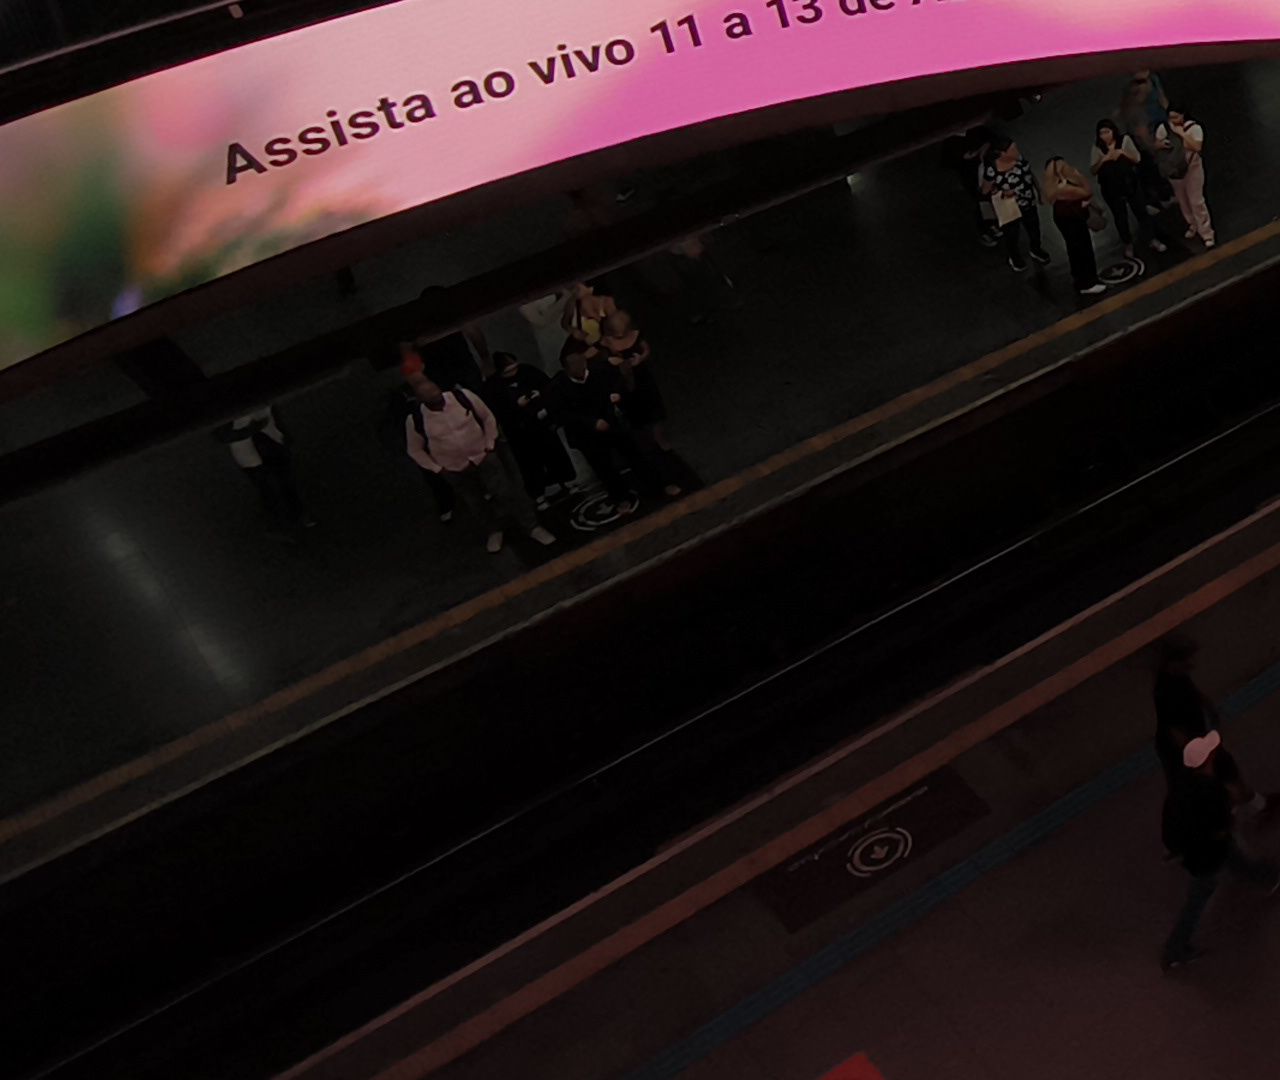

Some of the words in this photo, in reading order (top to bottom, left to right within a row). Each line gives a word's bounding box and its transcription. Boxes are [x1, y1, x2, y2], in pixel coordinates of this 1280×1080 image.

[225, 93, 437, 185] Assista
[450, 70, 516, 110] ao
[528, 37, 636, 85] vivo
[650, 13, 703, 55] 11
[723, 11, 754, 40] a
